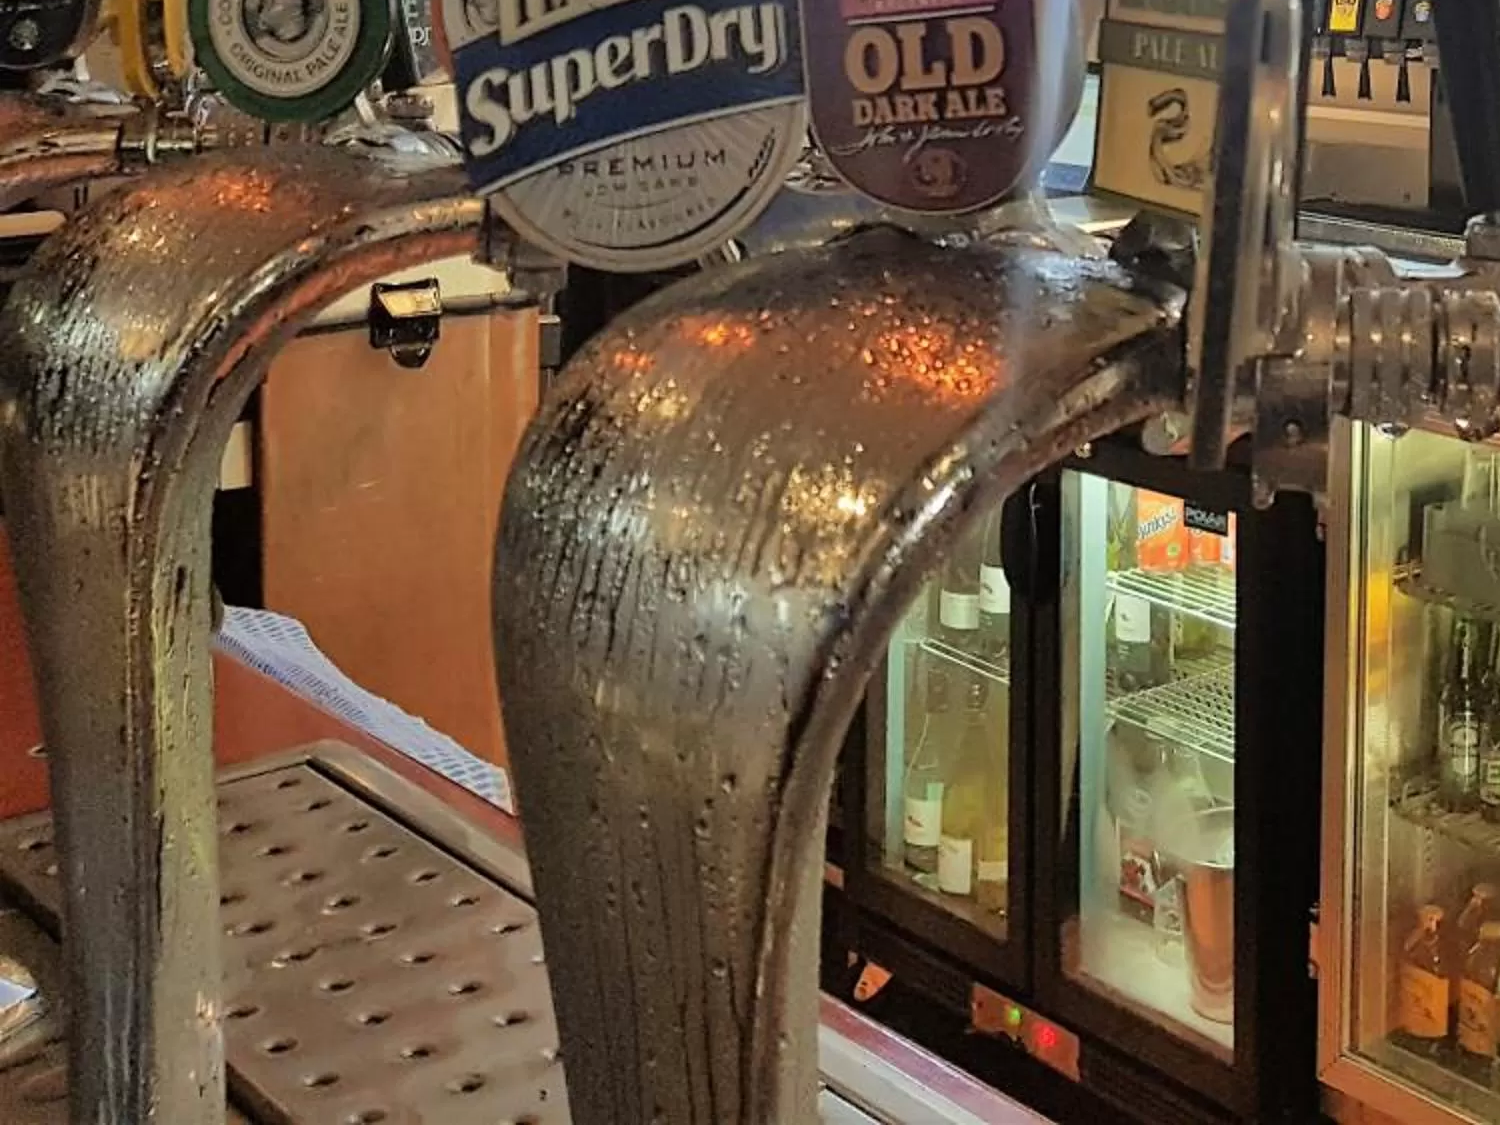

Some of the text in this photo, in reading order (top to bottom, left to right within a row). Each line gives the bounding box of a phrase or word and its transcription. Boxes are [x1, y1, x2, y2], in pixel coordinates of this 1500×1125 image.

[333, 2, 349, 35] ALE
[229, 42, 303, 85] ORIGINAL
[304, 37, 341, 76] PALE
[844, 15, 1005, 95] OLD
[1133, 28, 1220, 71] PALE AL
[465, 2, 786, 159] SuperDry
[852, 87, 1008, 127] DARK ALE
[556, 147, 727, 176] PREMIUM
